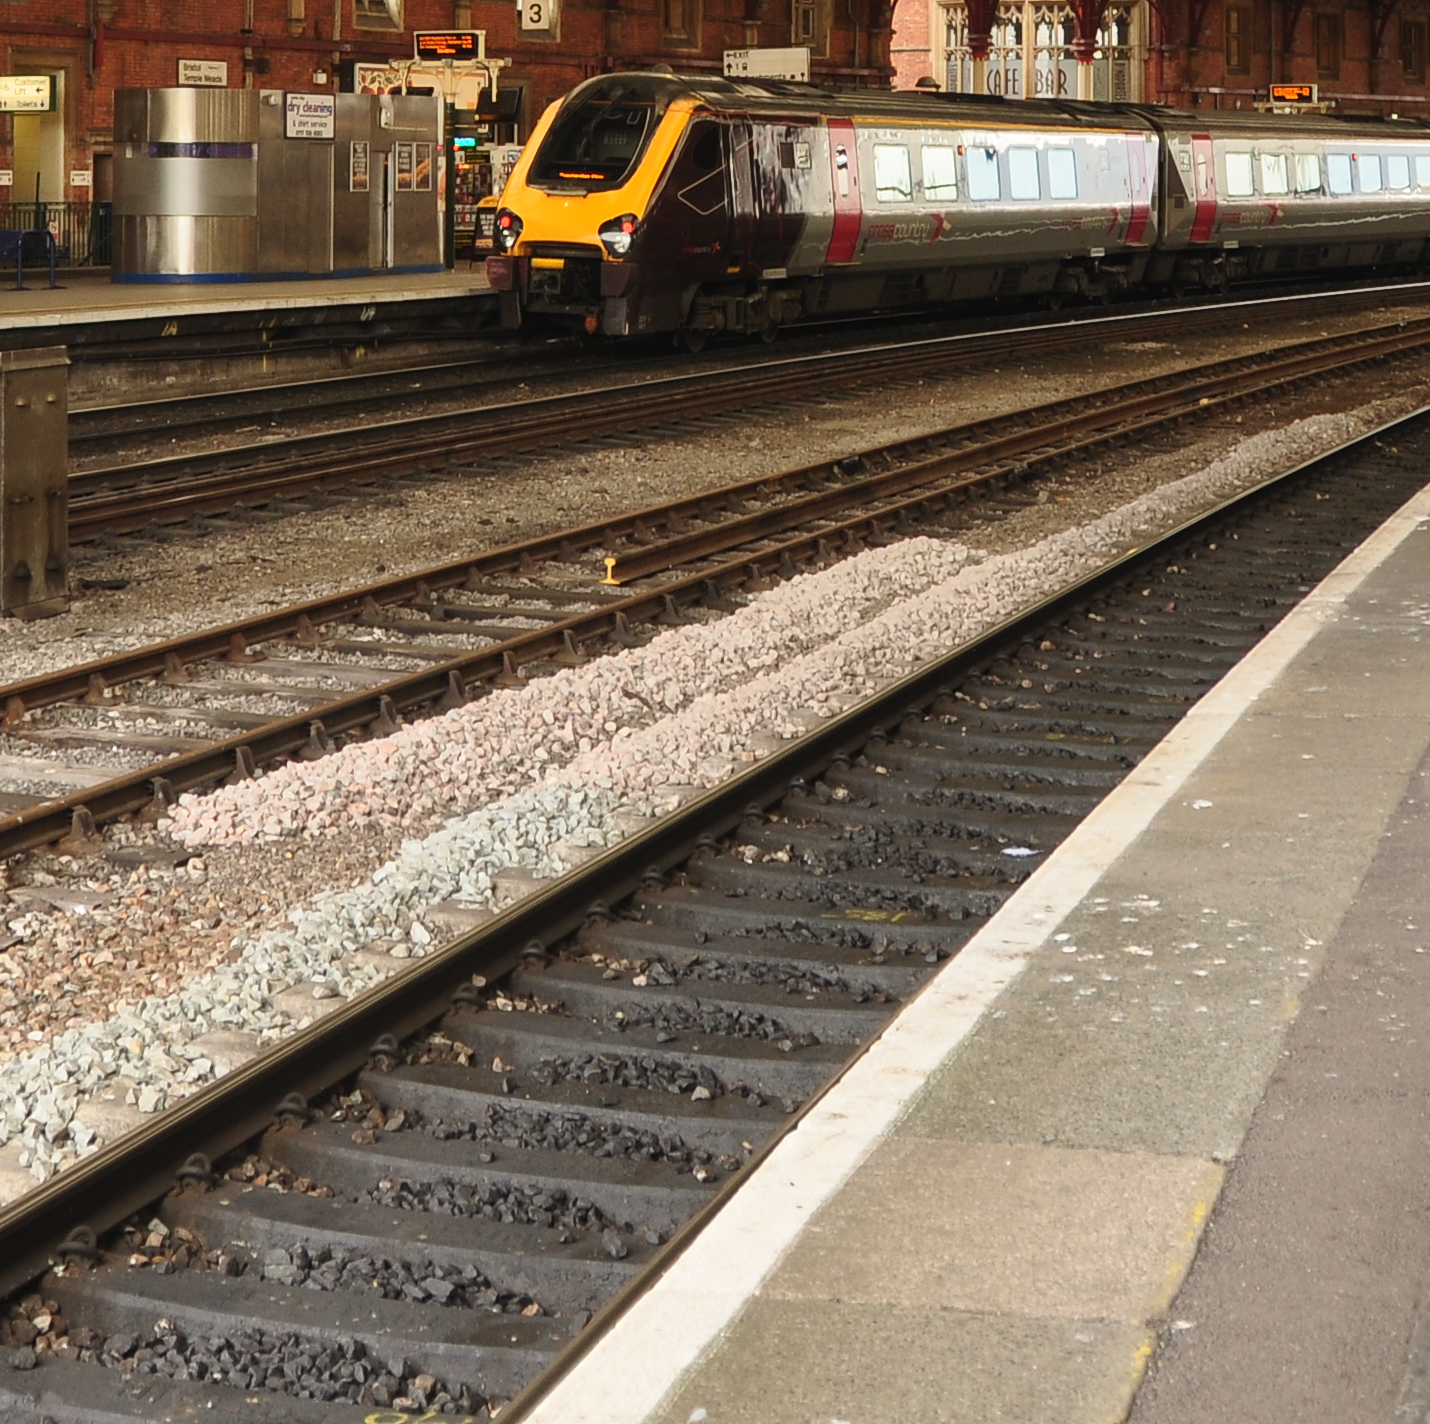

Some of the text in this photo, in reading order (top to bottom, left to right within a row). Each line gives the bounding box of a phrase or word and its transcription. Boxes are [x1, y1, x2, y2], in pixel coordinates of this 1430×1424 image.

[529, 3, 542, 24] 3
[183, 63, 201, 71] Bristol
[987, 68, 1019, 95] CAFE
[1036, 68, 1068, 94] BAR
[17, 100, 37, 108] Toilets
[288, 100, 332, 116] dry cleaning
[869, 221, 930, 243] crosscountry
